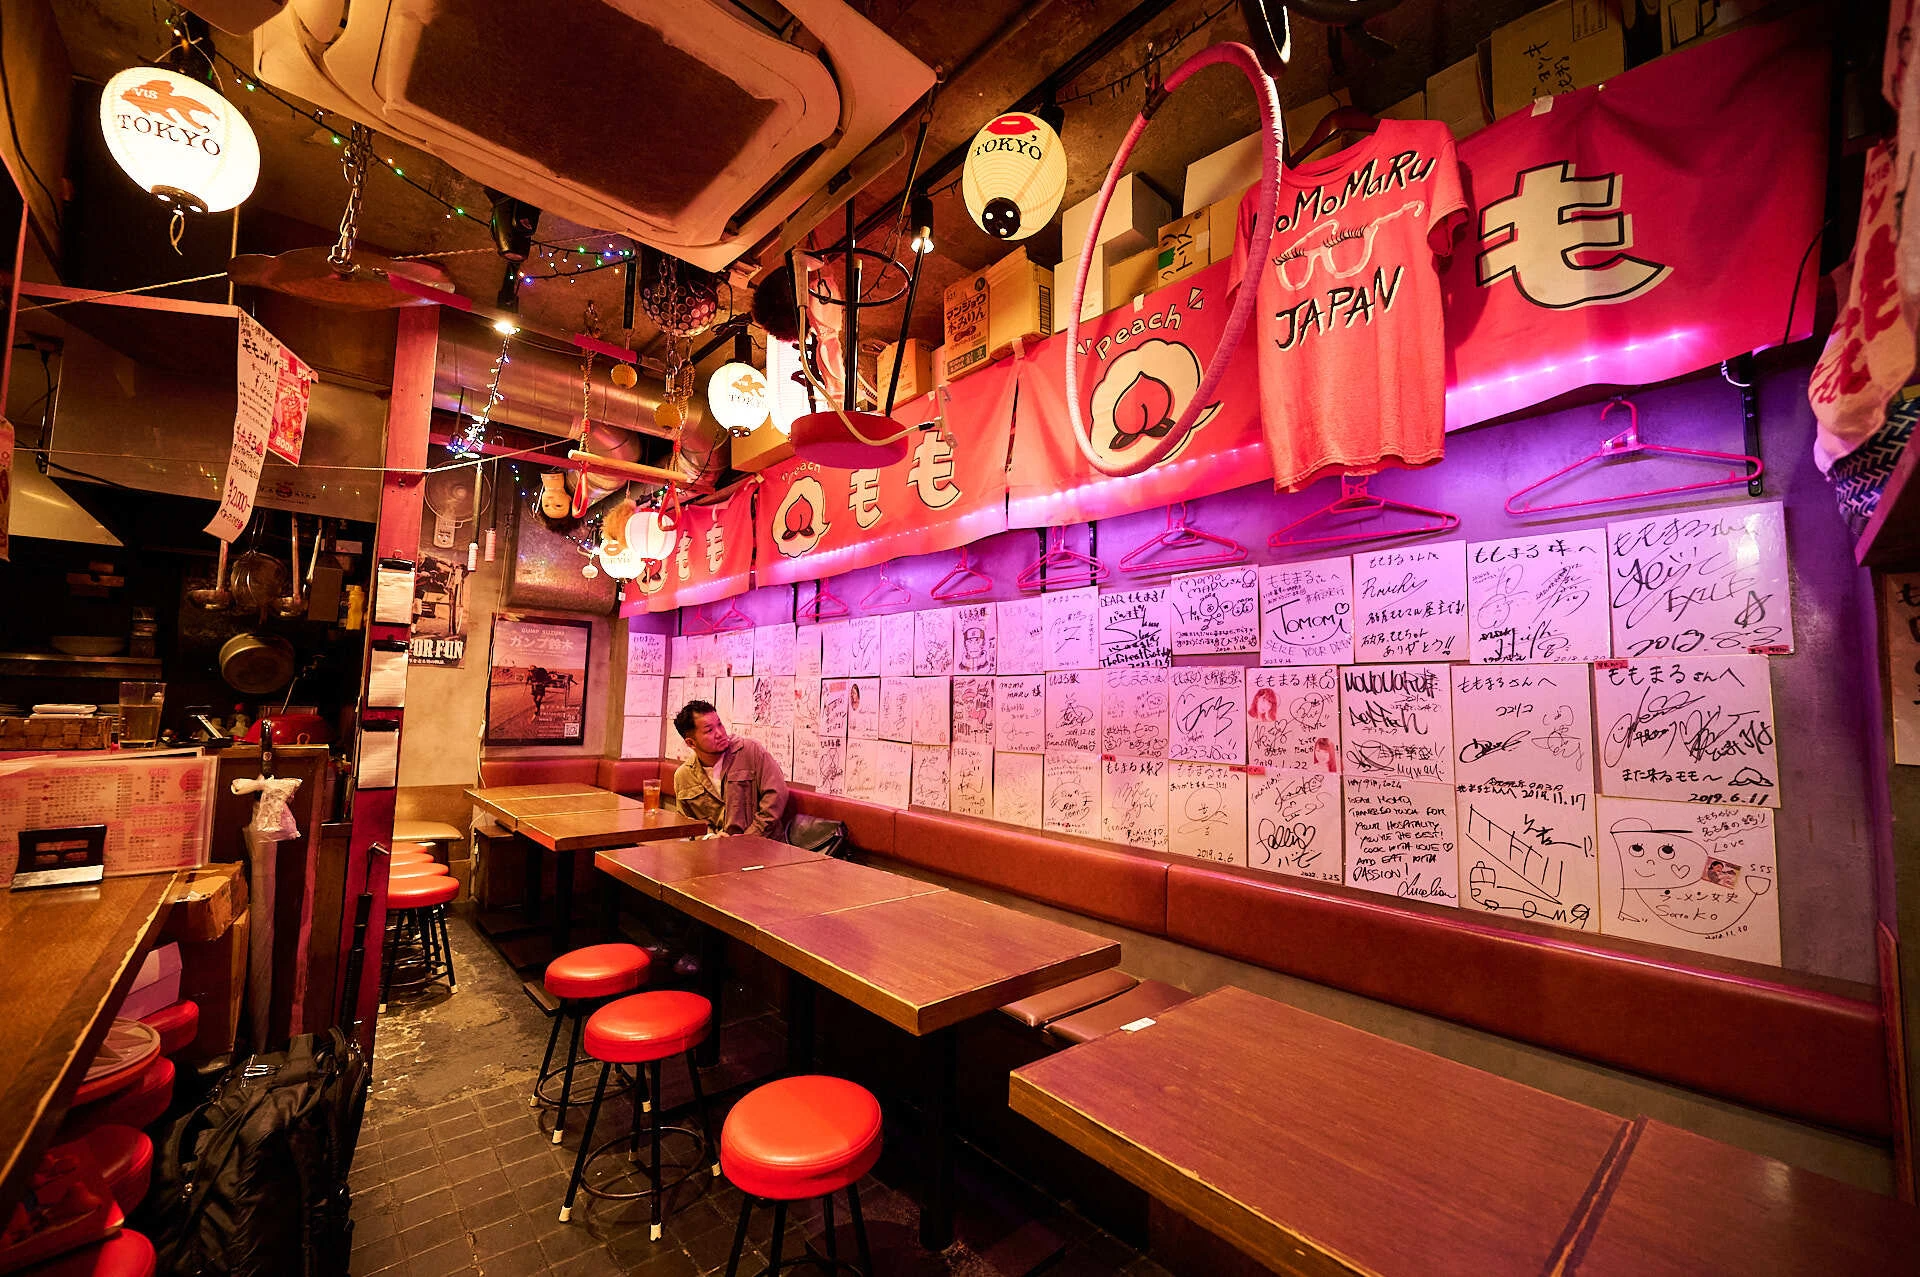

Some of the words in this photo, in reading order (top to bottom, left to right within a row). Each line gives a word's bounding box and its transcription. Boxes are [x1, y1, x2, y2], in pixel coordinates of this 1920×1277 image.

[1475, 160, 1675, 311] も
[1275, 265, 1405, 352] JAPAN
[1095, 304, 1182, 360] Peach
[1100, 594, 1125, 607] DEAR
[435, 639, 464, 659] FUN
[510, 636, 575, 650] ガンプ鈴木
[1608, 664, 1745, 687] ももまるさんへ
[1457, 676, 1557, 693] ももまるさんへ
[1688, 793, 1769, 806] 2019.6.11
[1426, 806, 1447, 817] FOR
[1395, 831, 1412, 841] THE
[1415, 843, 1440, 852] LOVE
[1197, 848, 1234, 863] 2019.2.6
